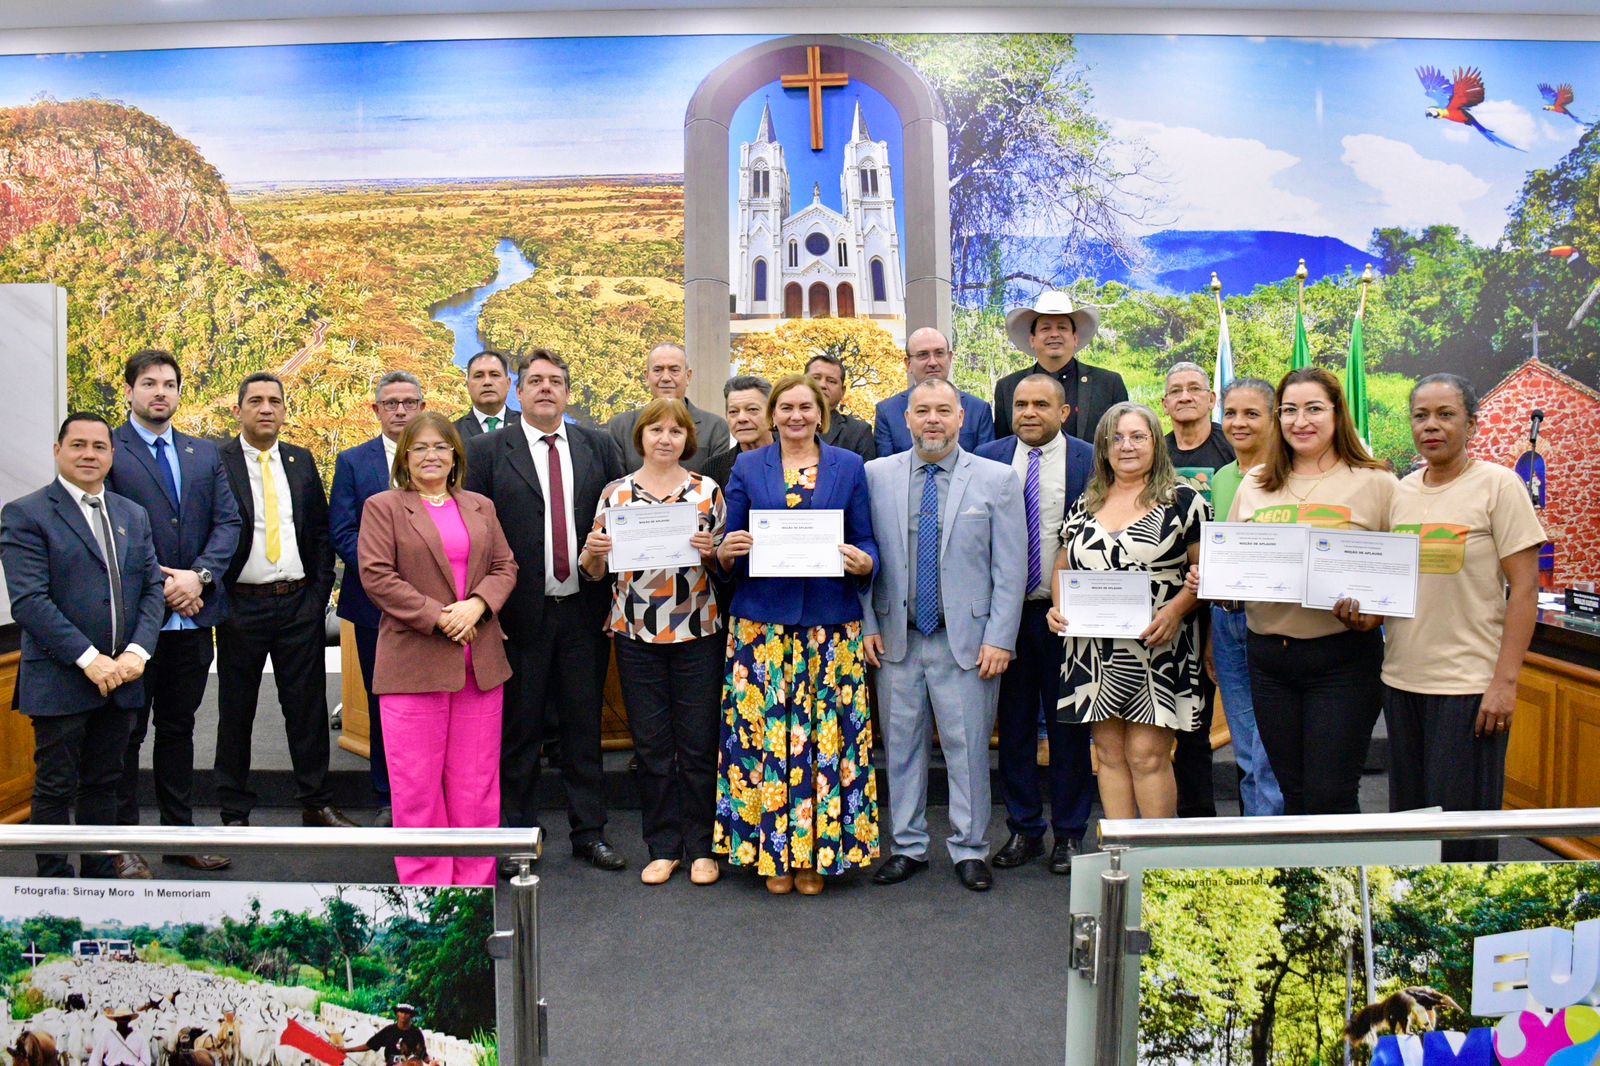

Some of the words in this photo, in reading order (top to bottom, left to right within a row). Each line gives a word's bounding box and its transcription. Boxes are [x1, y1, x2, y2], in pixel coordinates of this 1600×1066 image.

[1163, 877, 1221, 889] Fotografia:
[14, 885, 70, 898] Fotografia:
[73, 886, 105, 898] Sirnay
[108, 887, 135, 897] Moro
[144, 888, 154, 897] In
[157, 888, 211, 898] Memoriam
[1471, 918, 1600, 1017] EU
